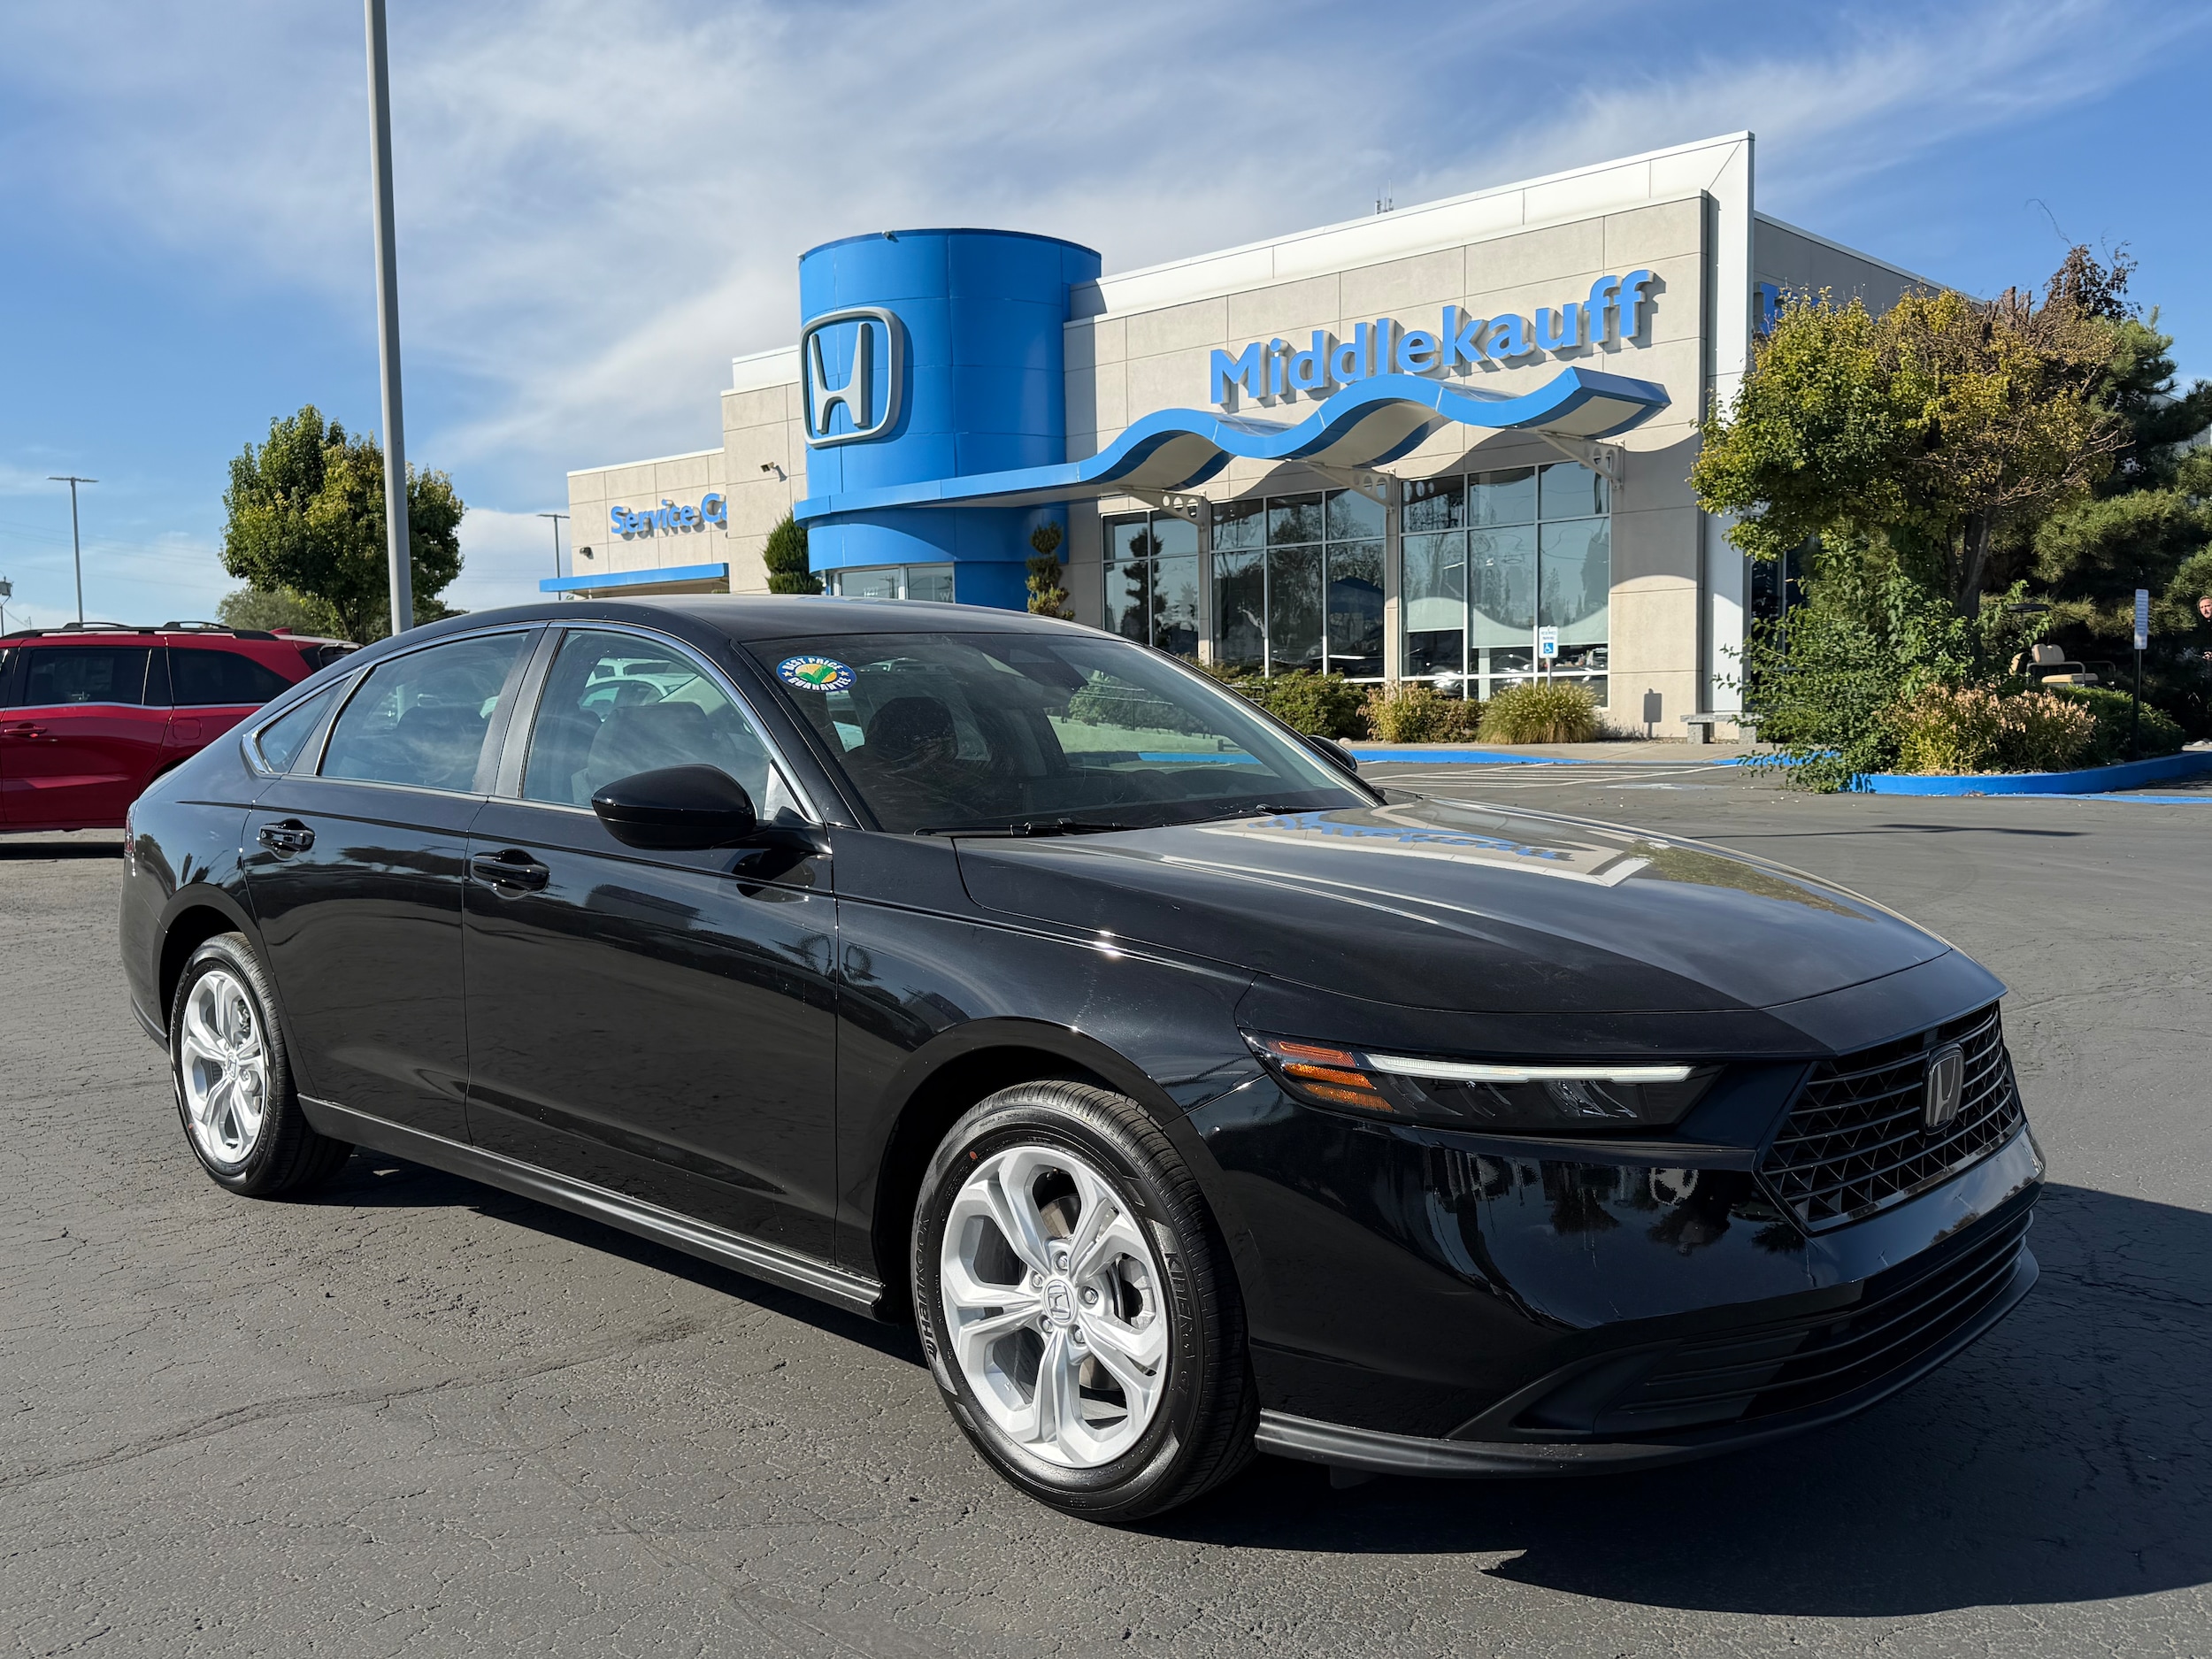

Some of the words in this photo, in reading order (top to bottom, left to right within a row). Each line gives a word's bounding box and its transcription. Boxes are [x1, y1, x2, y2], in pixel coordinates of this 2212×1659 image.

[1210, 269, 1654, 404] Middlekauff
[611, 498, 698, 534] Service
[781, 657, 806, 671] BEST
[808, 657, 844, 671] PRICE
[787, 676, 852, 691] GUARANTEE
